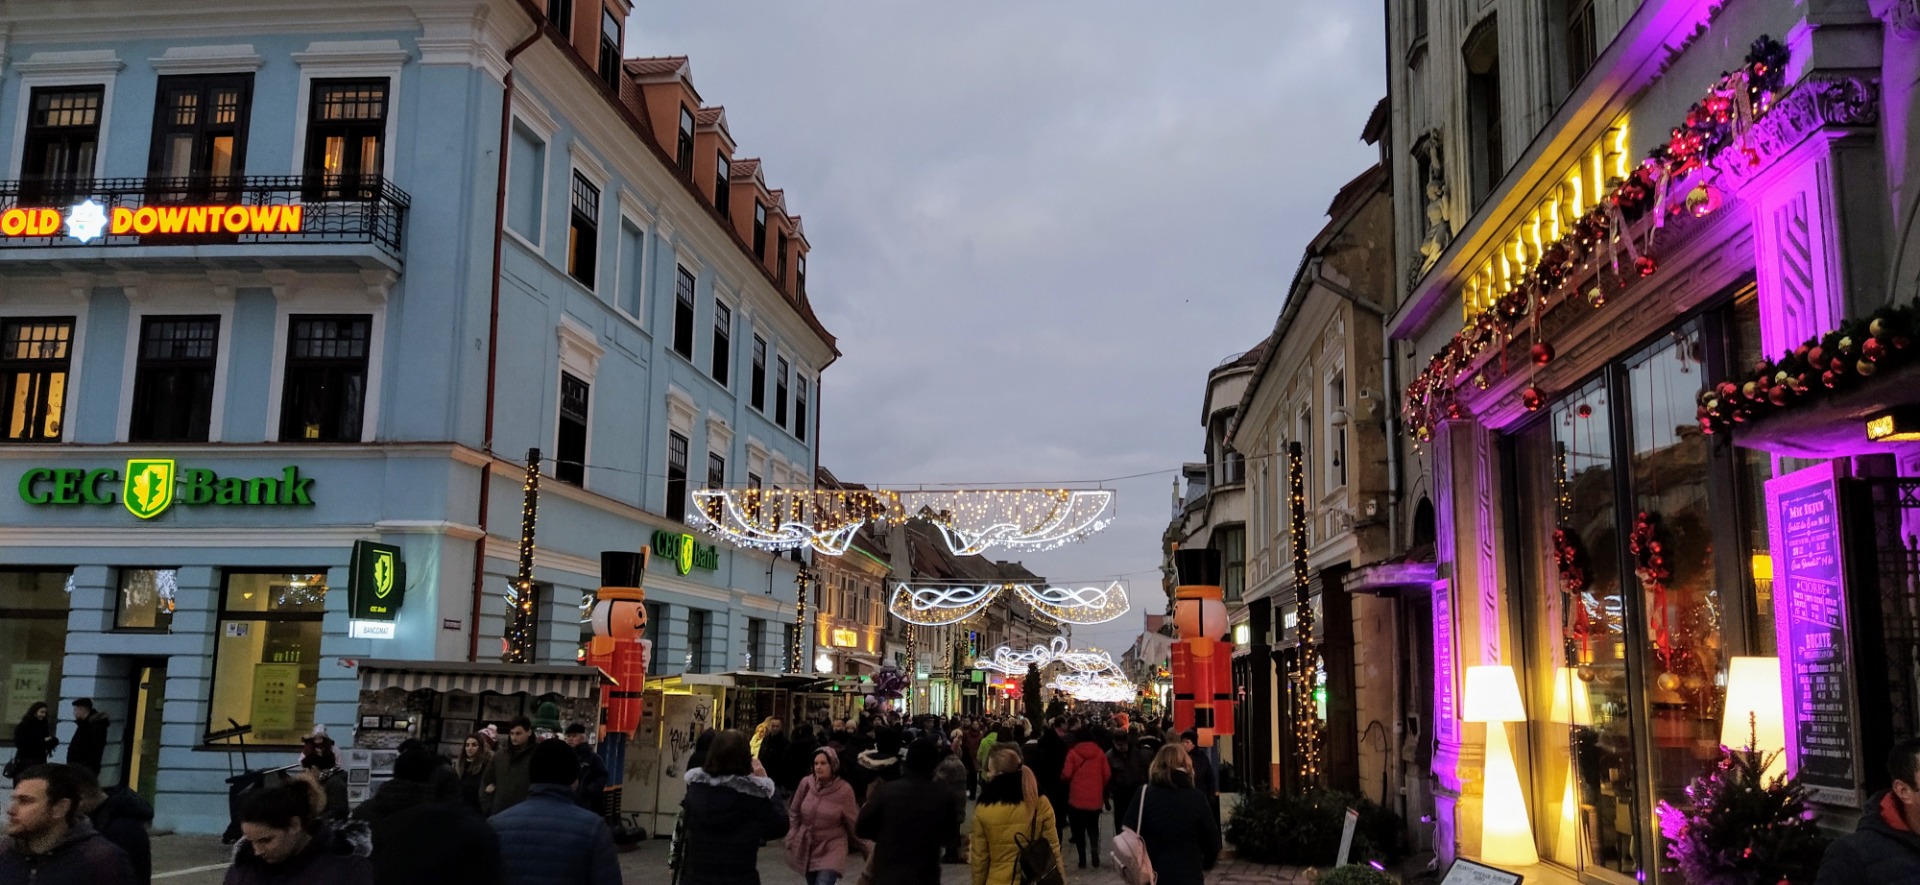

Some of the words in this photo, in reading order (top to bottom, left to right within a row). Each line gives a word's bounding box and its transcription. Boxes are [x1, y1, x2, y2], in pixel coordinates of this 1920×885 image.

[1, 208, 60, 235] OLD
[111, 205, 302, 234] DOWNTOWN
[18, 468, 118, 504] CEC
[184, 465, 316, 505] Bank
[651, 530, 681, 560] CEC
[692, 541, 719, 570] Bank
[363, 626, 389, 635] BANCOMAT
